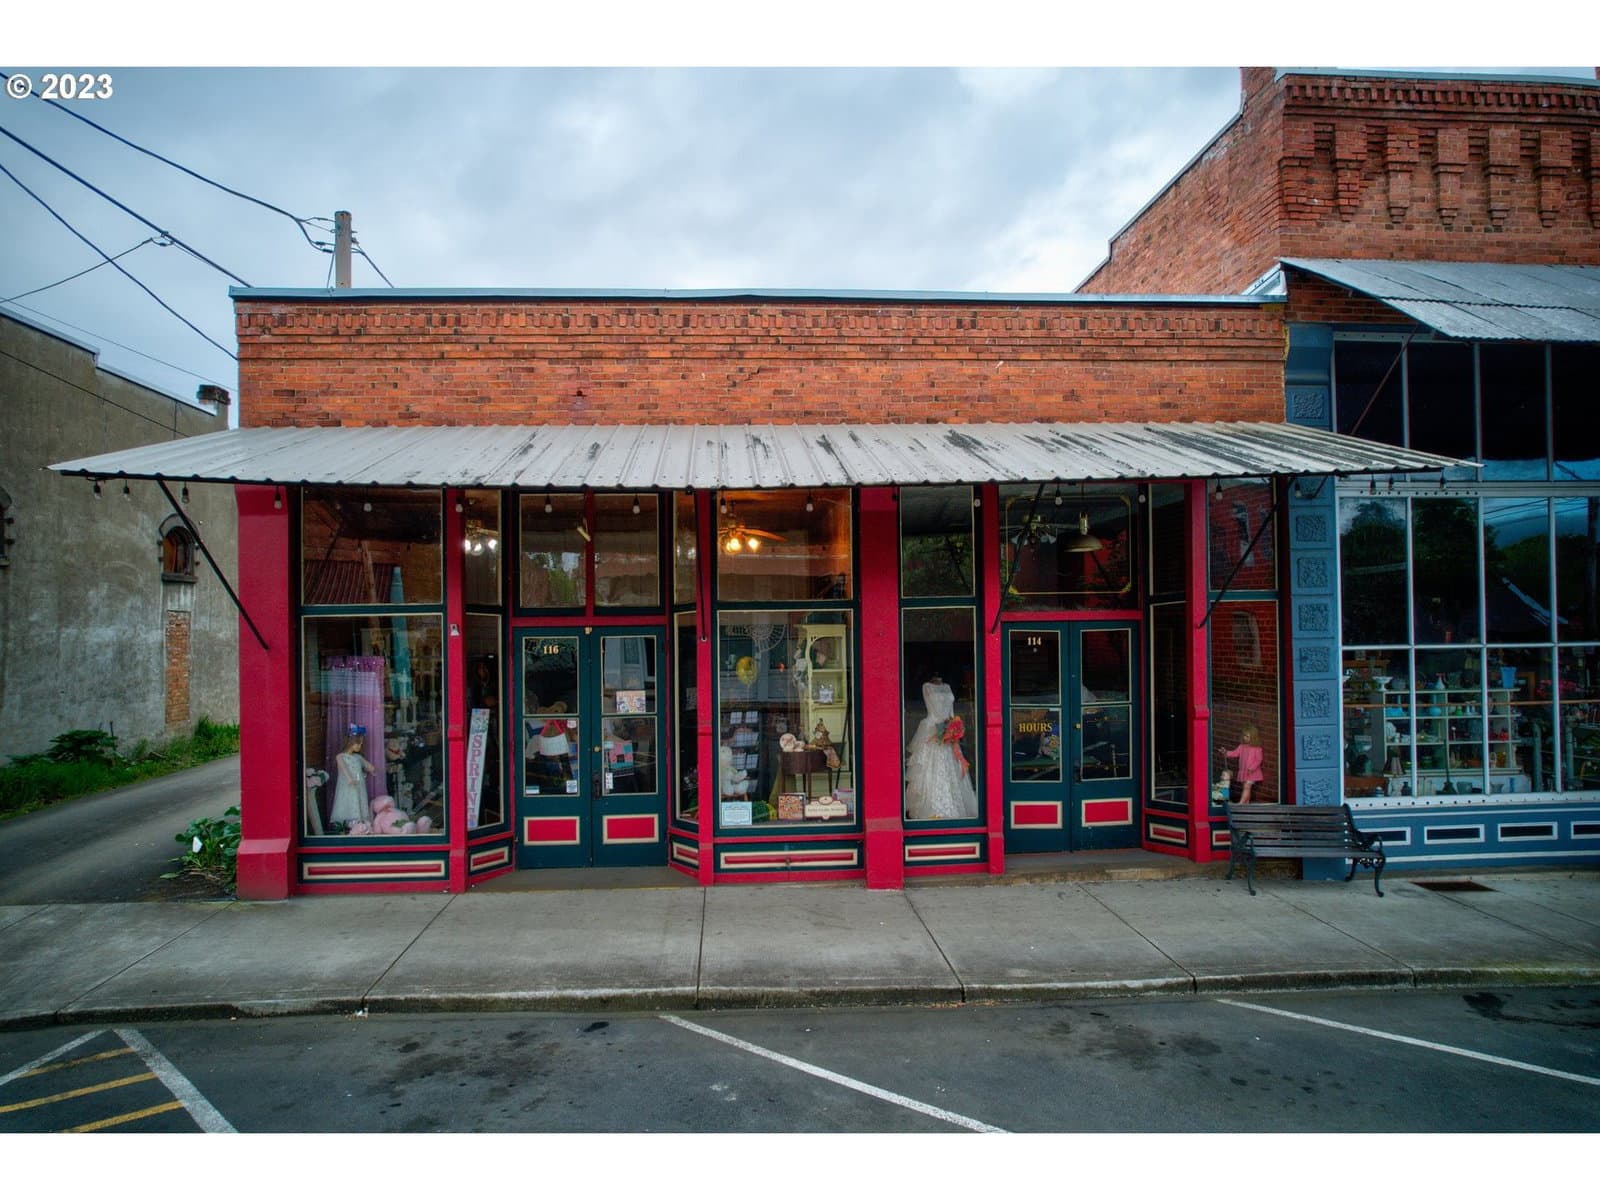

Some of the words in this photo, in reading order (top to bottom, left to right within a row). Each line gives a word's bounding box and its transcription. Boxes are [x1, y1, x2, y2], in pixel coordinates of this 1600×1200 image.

[1028, 636, 1041, 646] 114
[543, 645, 559, 654] 116
[1019, 722, 1053, 732] HOURS
